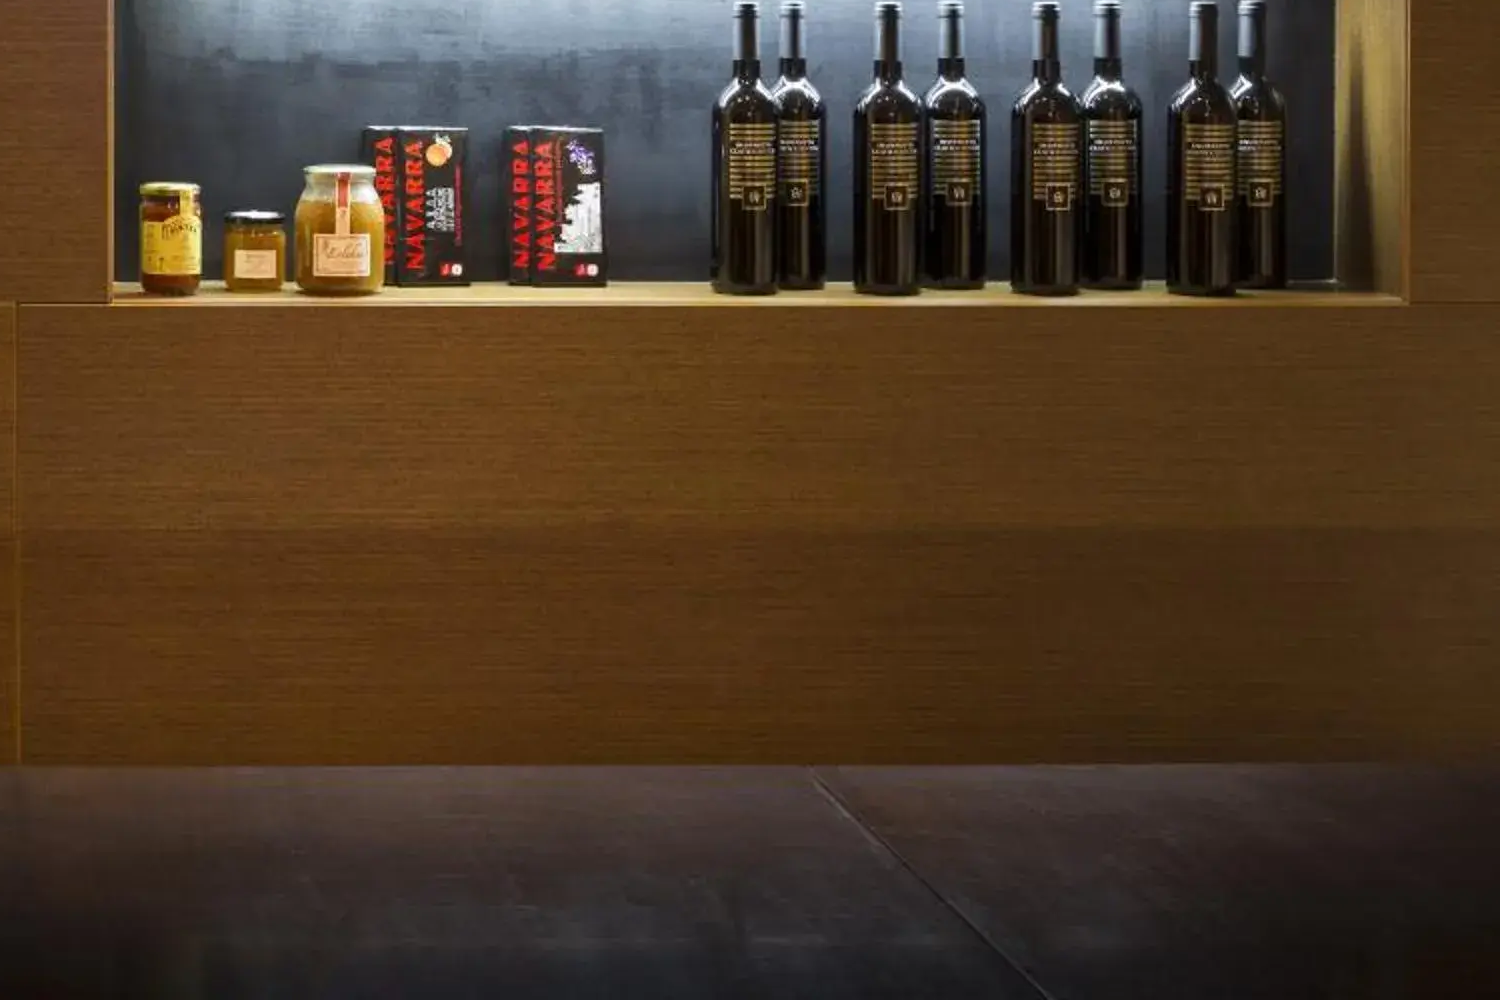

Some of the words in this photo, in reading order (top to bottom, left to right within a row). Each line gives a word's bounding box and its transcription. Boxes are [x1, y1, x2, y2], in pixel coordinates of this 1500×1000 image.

[404, 141, 426, 270] NAVARRA
[513, 140, 531, 268] NAVARRA
[535, 141, 556, 271] NAVARRA
